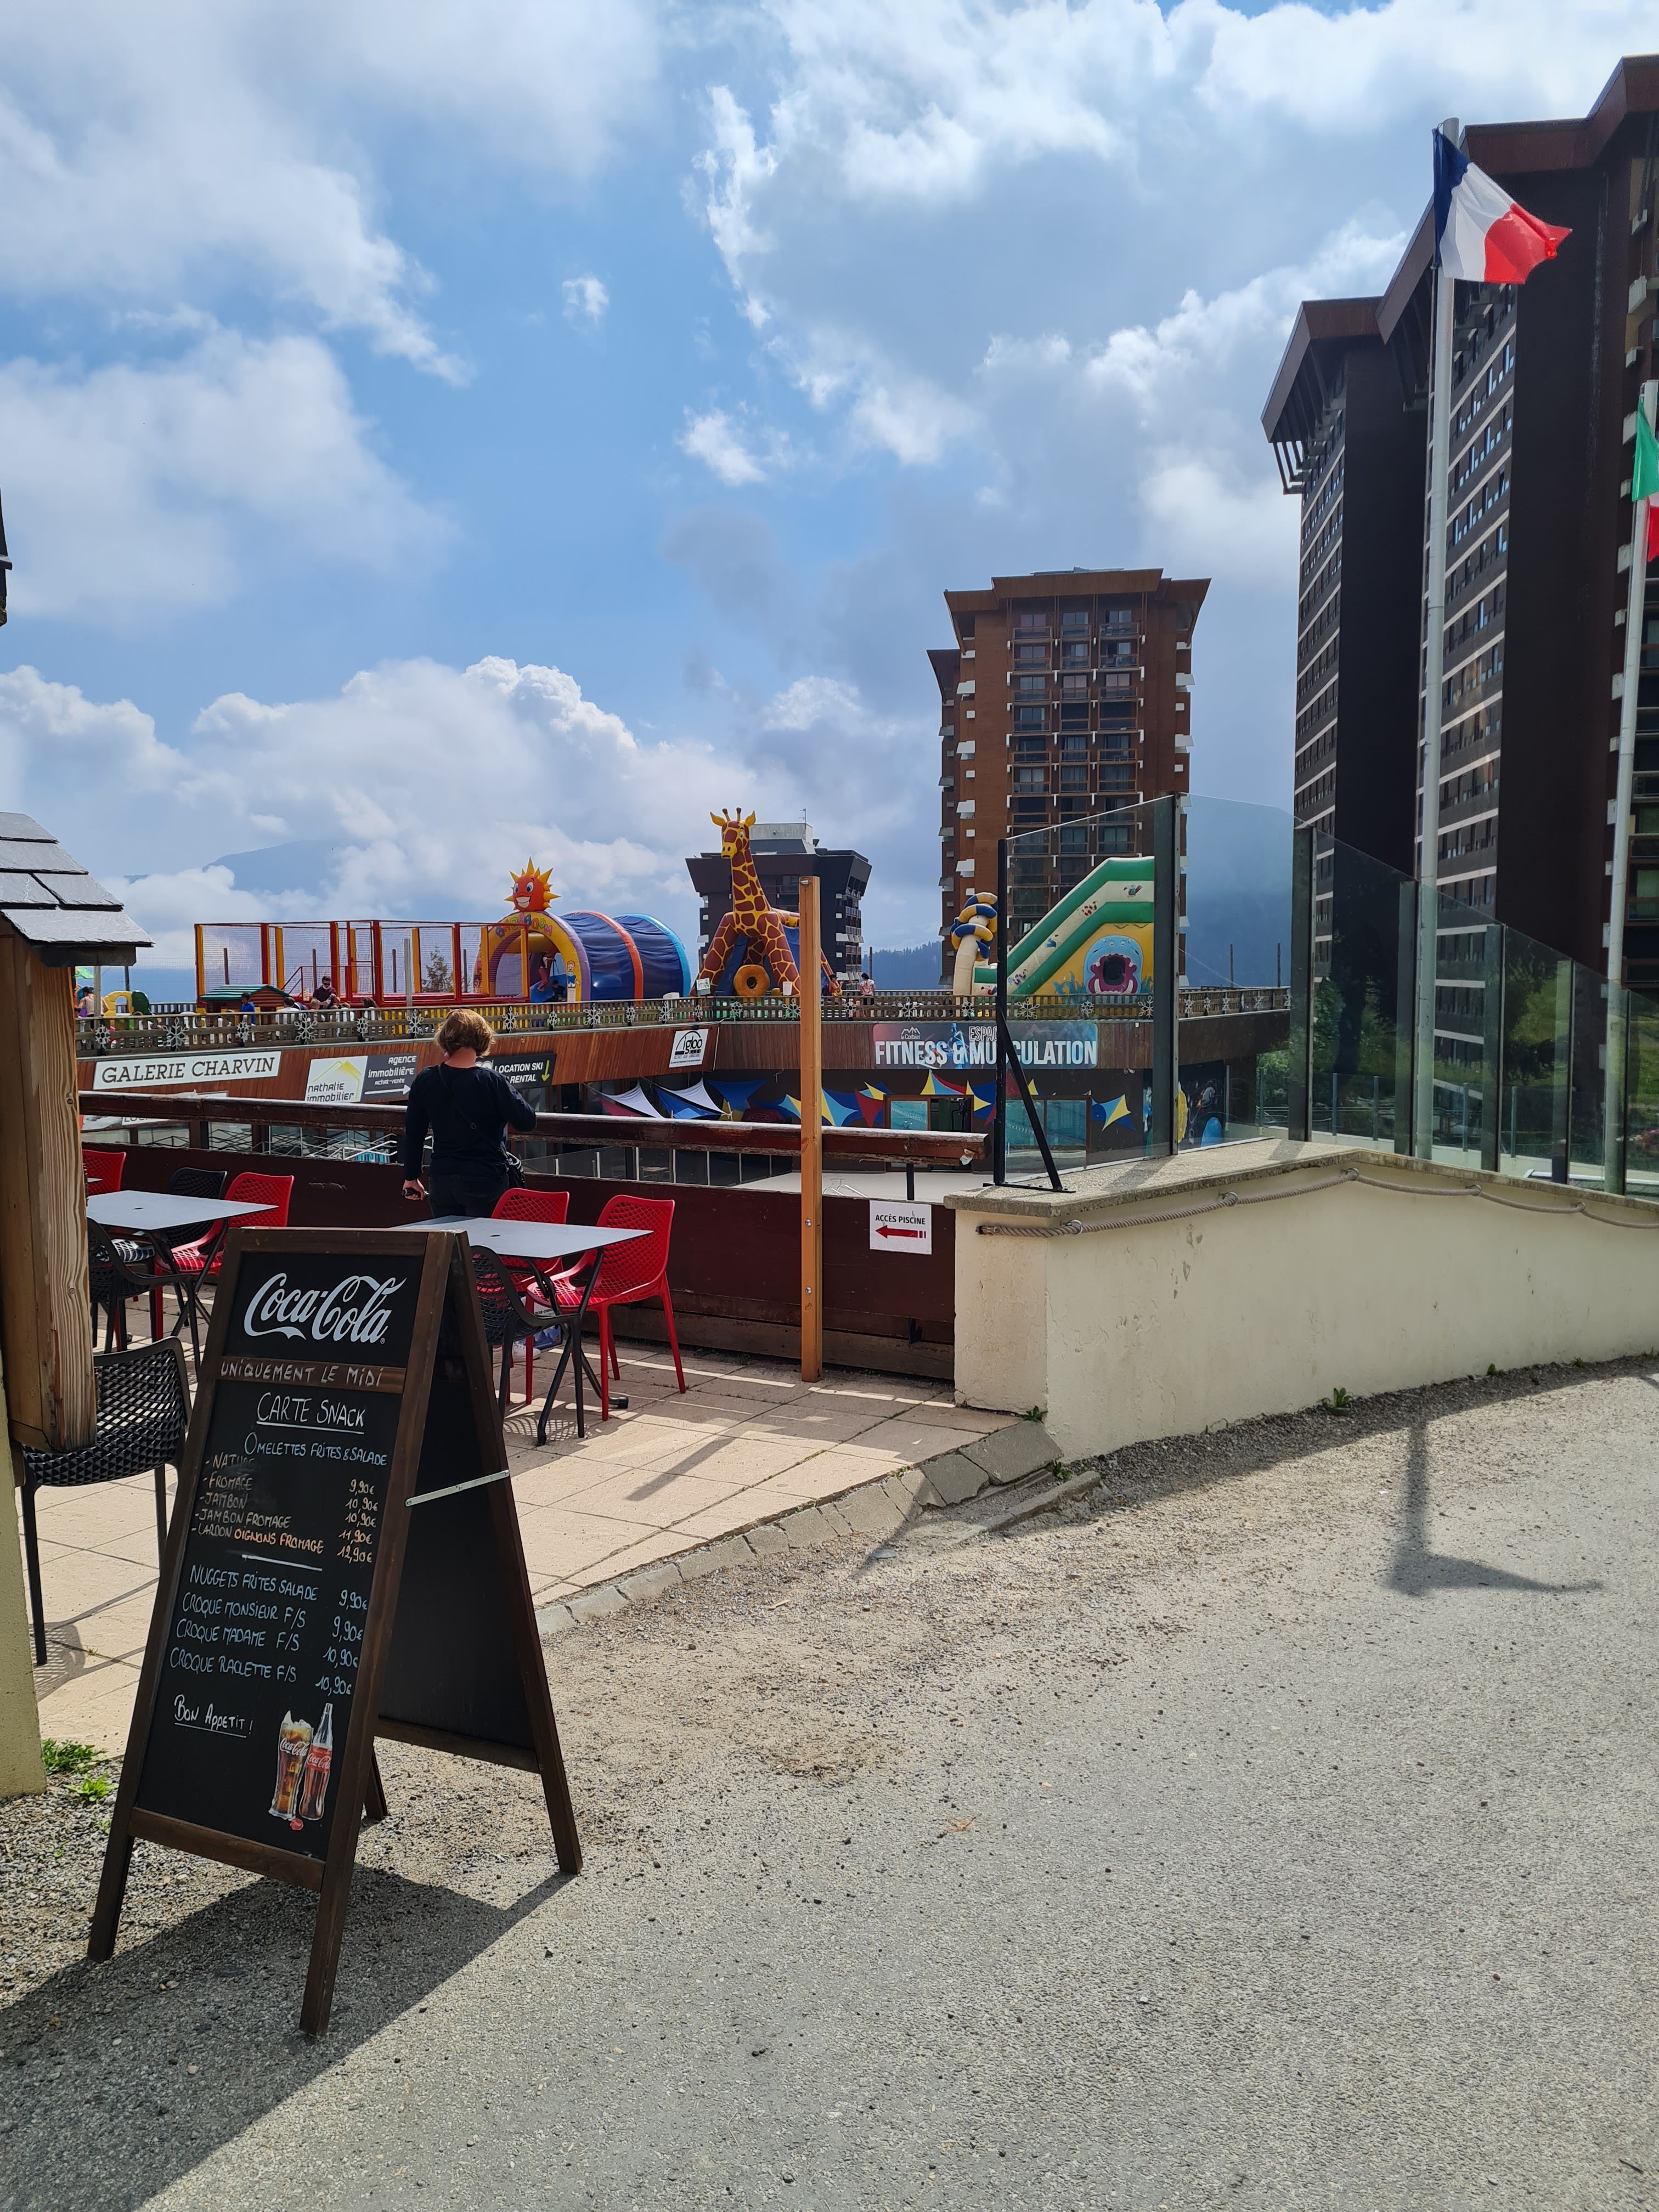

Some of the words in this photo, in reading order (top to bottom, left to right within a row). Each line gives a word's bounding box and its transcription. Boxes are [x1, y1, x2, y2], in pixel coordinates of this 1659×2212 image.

[969, 1026, 997, 1041] ESPAC
[875, 1041, 949, 1065] FITNESS
[953, 1041, 966, 1065] &
[969, 1040, 1097, 1065] MUCULATION
[101, 1062, 186, 1084] GALERIE
[191, 1057, 275, 1078] CHARVIN
[368, 1066, 415, 1079] immobilière
[494, 1063, 531, 1074] LOCATION
[531, 1062, 544, 1070] SKI
[509, 1074, 537, 1084] RENTAL
[307, 1092, 354, 1103] immobilier
[875, 1213, 897, 1222] ACCÈS
[898, 1216, 926, 1224] PISCINE
[244, 1273, 407, 1344] Coca-Cola
[221, 1358, 316, 1383] UNIQUEMENT
[320, 1365, 339, 1383] LE
[346, 1367, 384, 1386] MIDI
[257, 1392, 312, 1423] CARTE
[317, 1399, 366, 1427] SNACK
[245, 1432, 306, 1457] OMELETTES
[311, 1442, 341, 1459] FRITES
[349, 1447, 388, 1466] SALADE
[349, 1479, 375, 1496] 9,90€
[345, 1497, 379, 1514] 10,90€
[246, 1511, 292, 1529] FROMAGE
[345, 1513, 377, 1528] 10,90€
[234, 1526, 276, 1545] OIGNONS
[279, 1537, 325, 1554] FROMAGE
[338, 1529, 373, 1546] 11,90€
[336, 1545, 373, 1564] 12,90€
[190, 1565, 240, 1588] NUGGETS
[242, 1571, 276, 1592] FRITES
[278, 1579, 319, 1601] SALADE
[338, 1589, 368, 1610] 9,90€
[182, 1592, 223, 1617] CROQUE
[224, 1600, 278, 1620] MONSIEUR
[284, 1606, 306, 1629] F/S
[331, 1616, 363, 1643] 9,90€
[176, 1618, 220, 1643] CROQUE
[222, 1627, 267, 1647] MADAME
[276, 1631, 300, 1651] F/S
[322, 1646, 358, 1668] 10,90€
[170, 1647, 215, 1674] CROQUE
[218, 1655, 272, 1679] RACLETTE
[276, 1665, 297, 1683] F/S
[315, 1675, 352, 1696] 10,90€
[174, 1694, 199, 1722] BON
